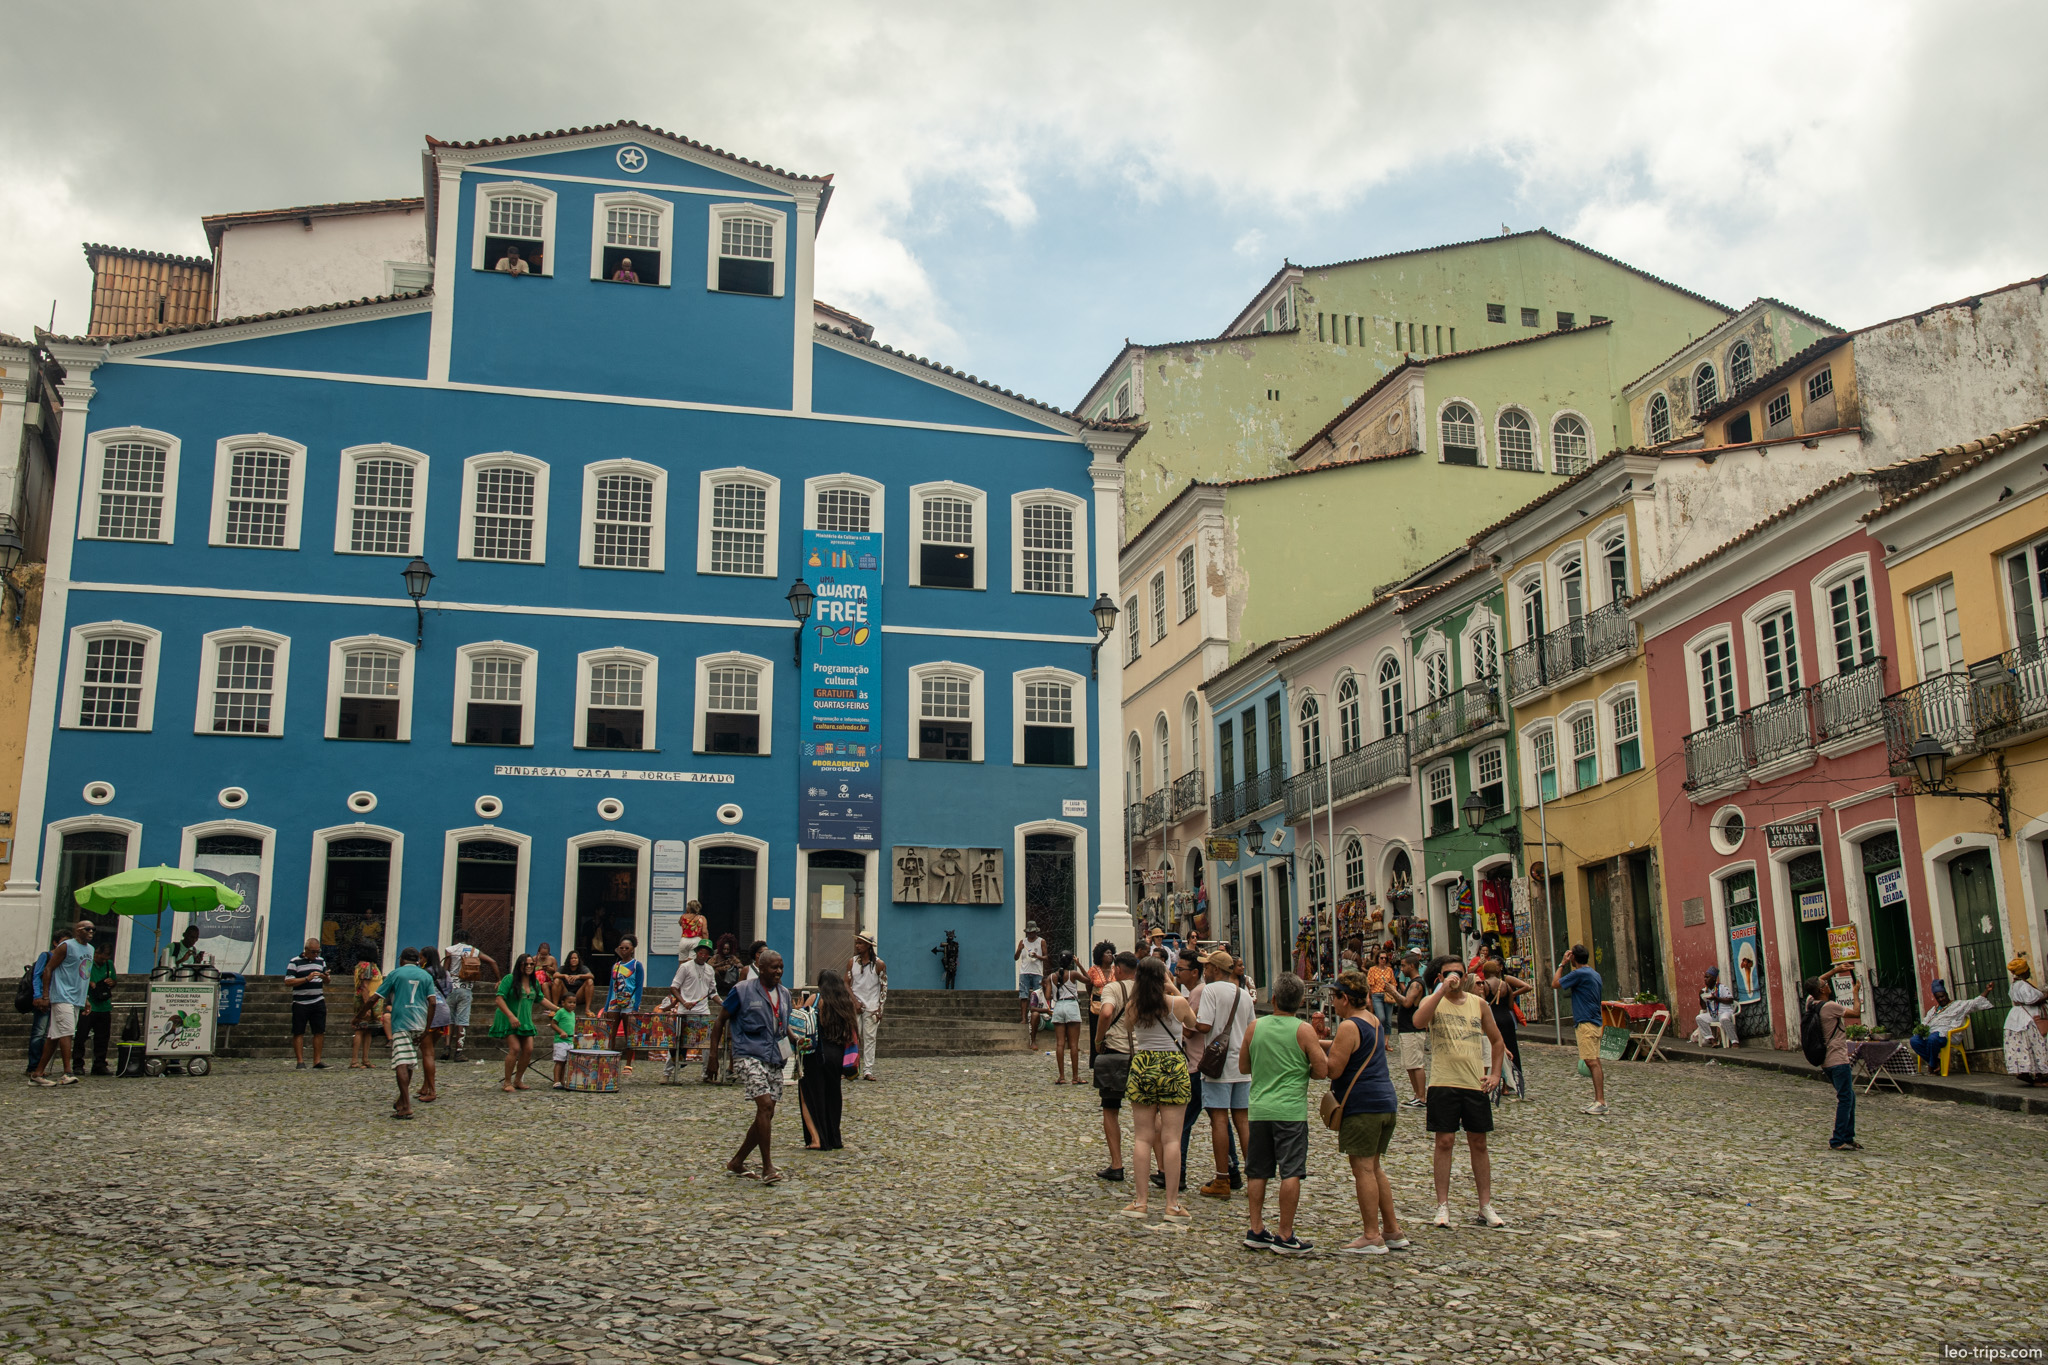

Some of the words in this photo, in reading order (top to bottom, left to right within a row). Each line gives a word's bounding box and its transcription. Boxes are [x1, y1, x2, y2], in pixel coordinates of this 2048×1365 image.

[817, 584, 868, 599] QUARTA
[816, 600, 868, 622] FREE
[813, 663, 869, 676] Programação
[825, 676, 858, 686] cultural
[816, 689, 854, 698] GRATUITA
[859, 690, 868, 699] às
[814, 701, 869, 710] QUARTAS-FEIRAS
[577, 769, 611, 778] CASA
[640, 771, 680, 780] JORGE
[691, 774, 734, 782] AMADO
[1878, 870, 1901, 885] CERVEJA
[1885, 882, 1897, 893] BEM
[1802, 894, 1823, 906] SORVETE
[1883, 890, 1903, 904] GELADA
[1803, 906, 1824, 918] PICOLÉ
[1732, 926, 1756, 940] SORVETE
[1829, 928, 1855, 944] Picolé
[409, 980, 419, 1003] 7
